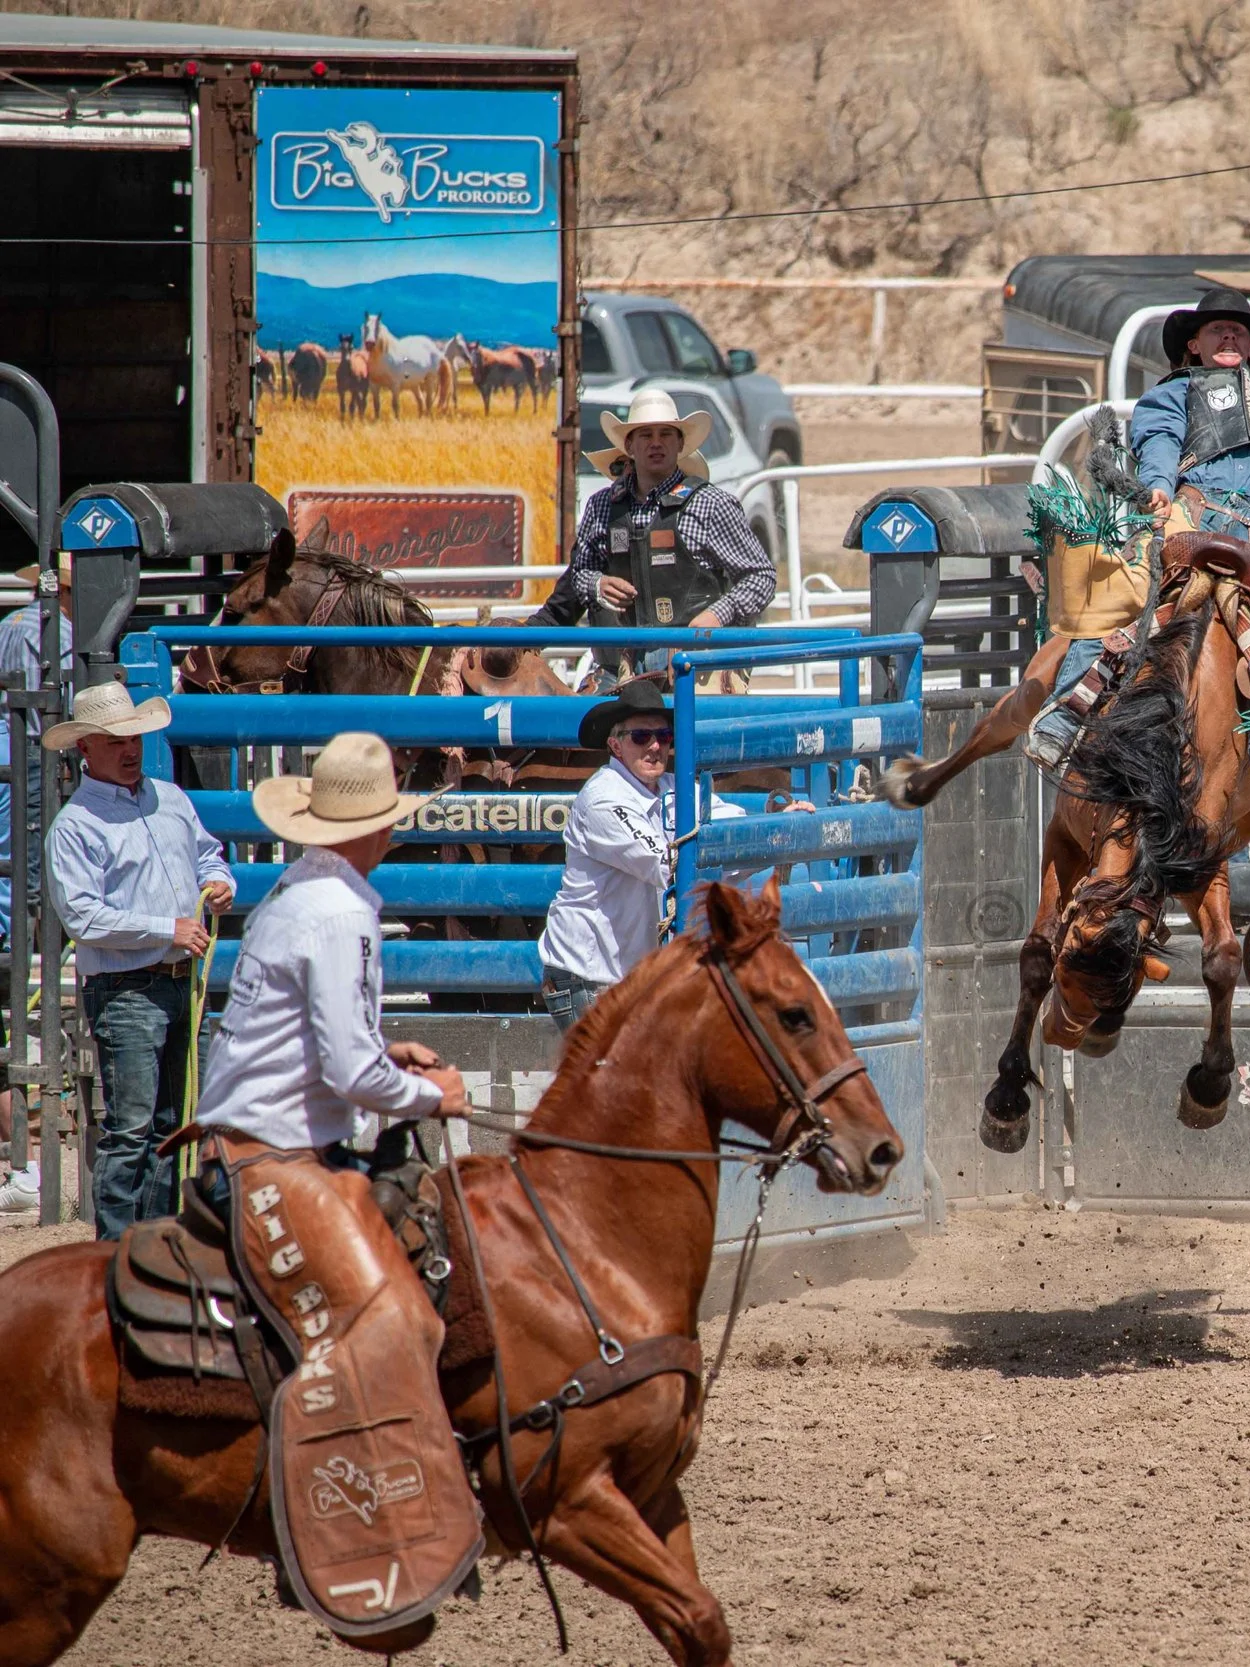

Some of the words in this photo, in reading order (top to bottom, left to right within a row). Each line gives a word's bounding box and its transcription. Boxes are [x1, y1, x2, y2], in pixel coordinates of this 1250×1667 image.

[401, 144, 527, 201] BUCKS
[437, 189, 532, 205] PRORODEO
[484, 700, 513, 746] 1
[249, 1184, 304, 1275] BIG
